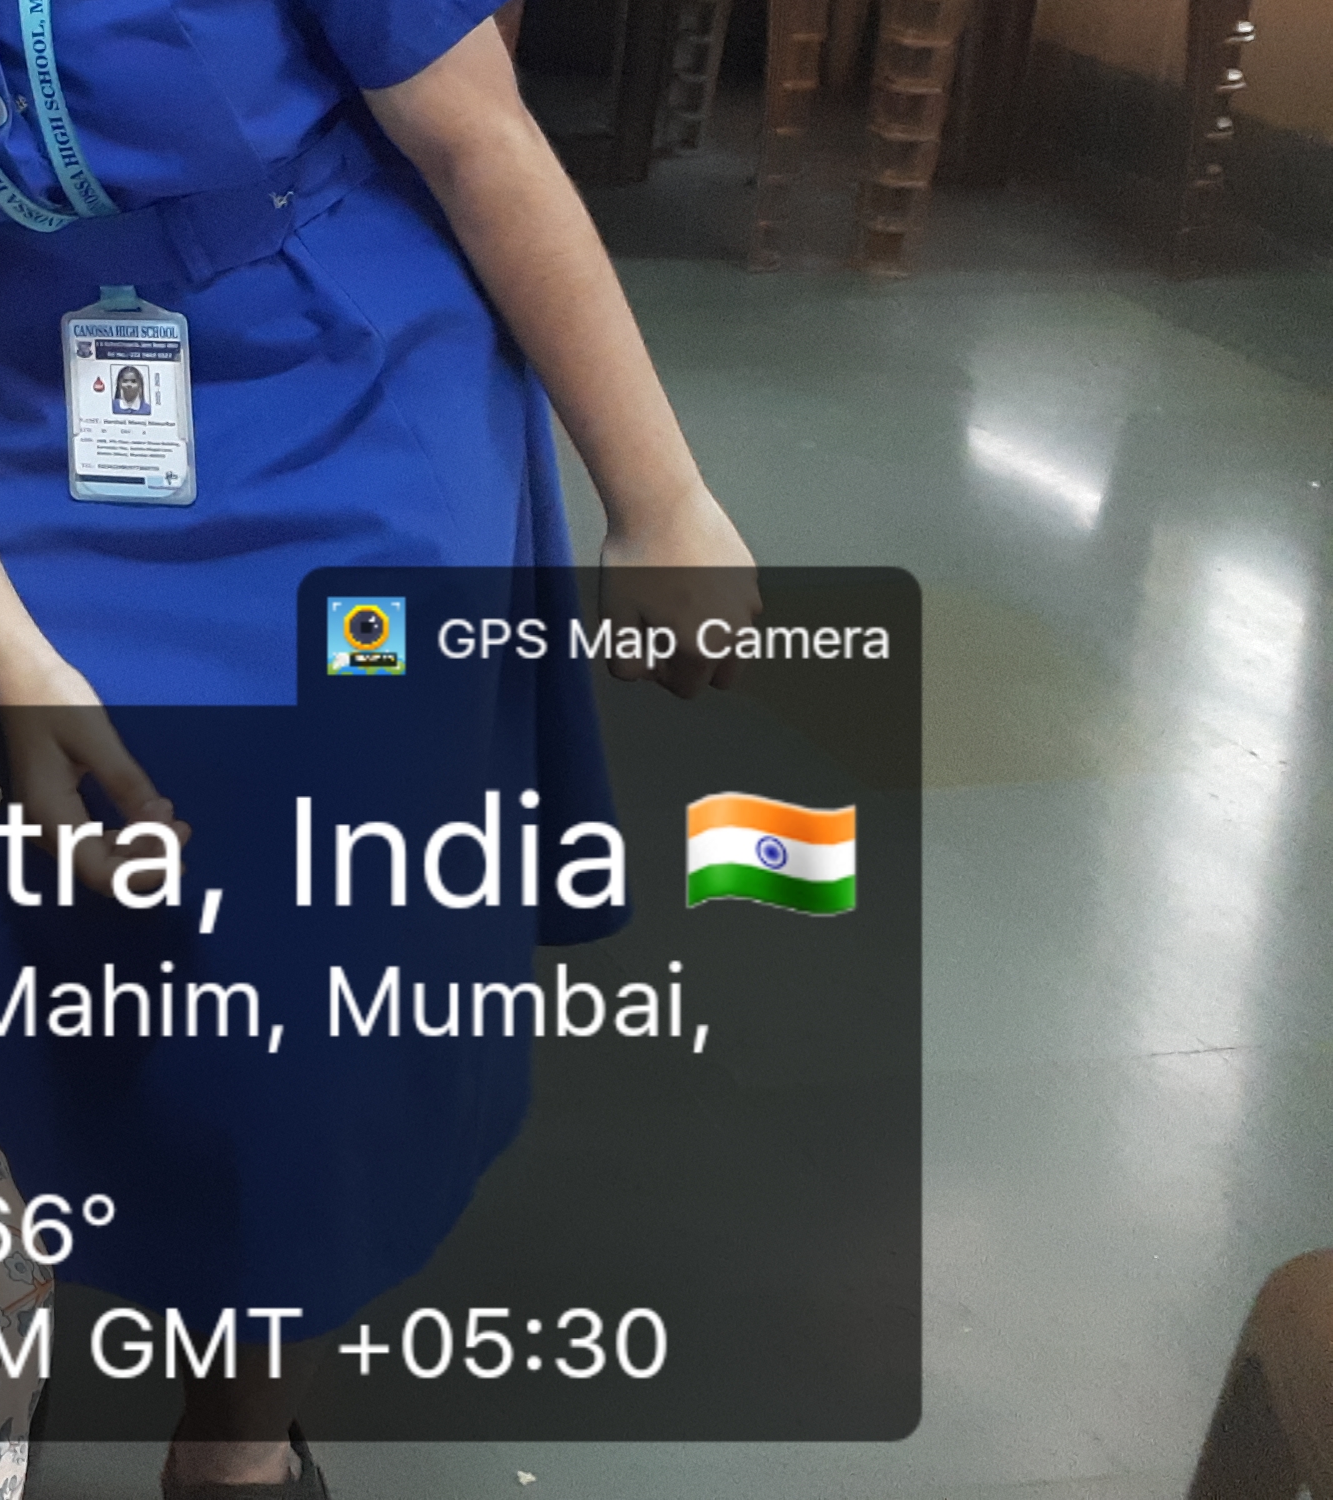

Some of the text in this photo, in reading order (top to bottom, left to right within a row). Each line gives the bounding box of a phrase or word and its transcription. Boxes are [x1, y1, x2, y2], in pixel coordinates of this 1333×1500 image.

[31, 19, 60, 112] SCHOOL,
[49, 116, 80, 168] HIGH
[74, 325, 178, 338] CANOSSA HIGH SCHOOL
